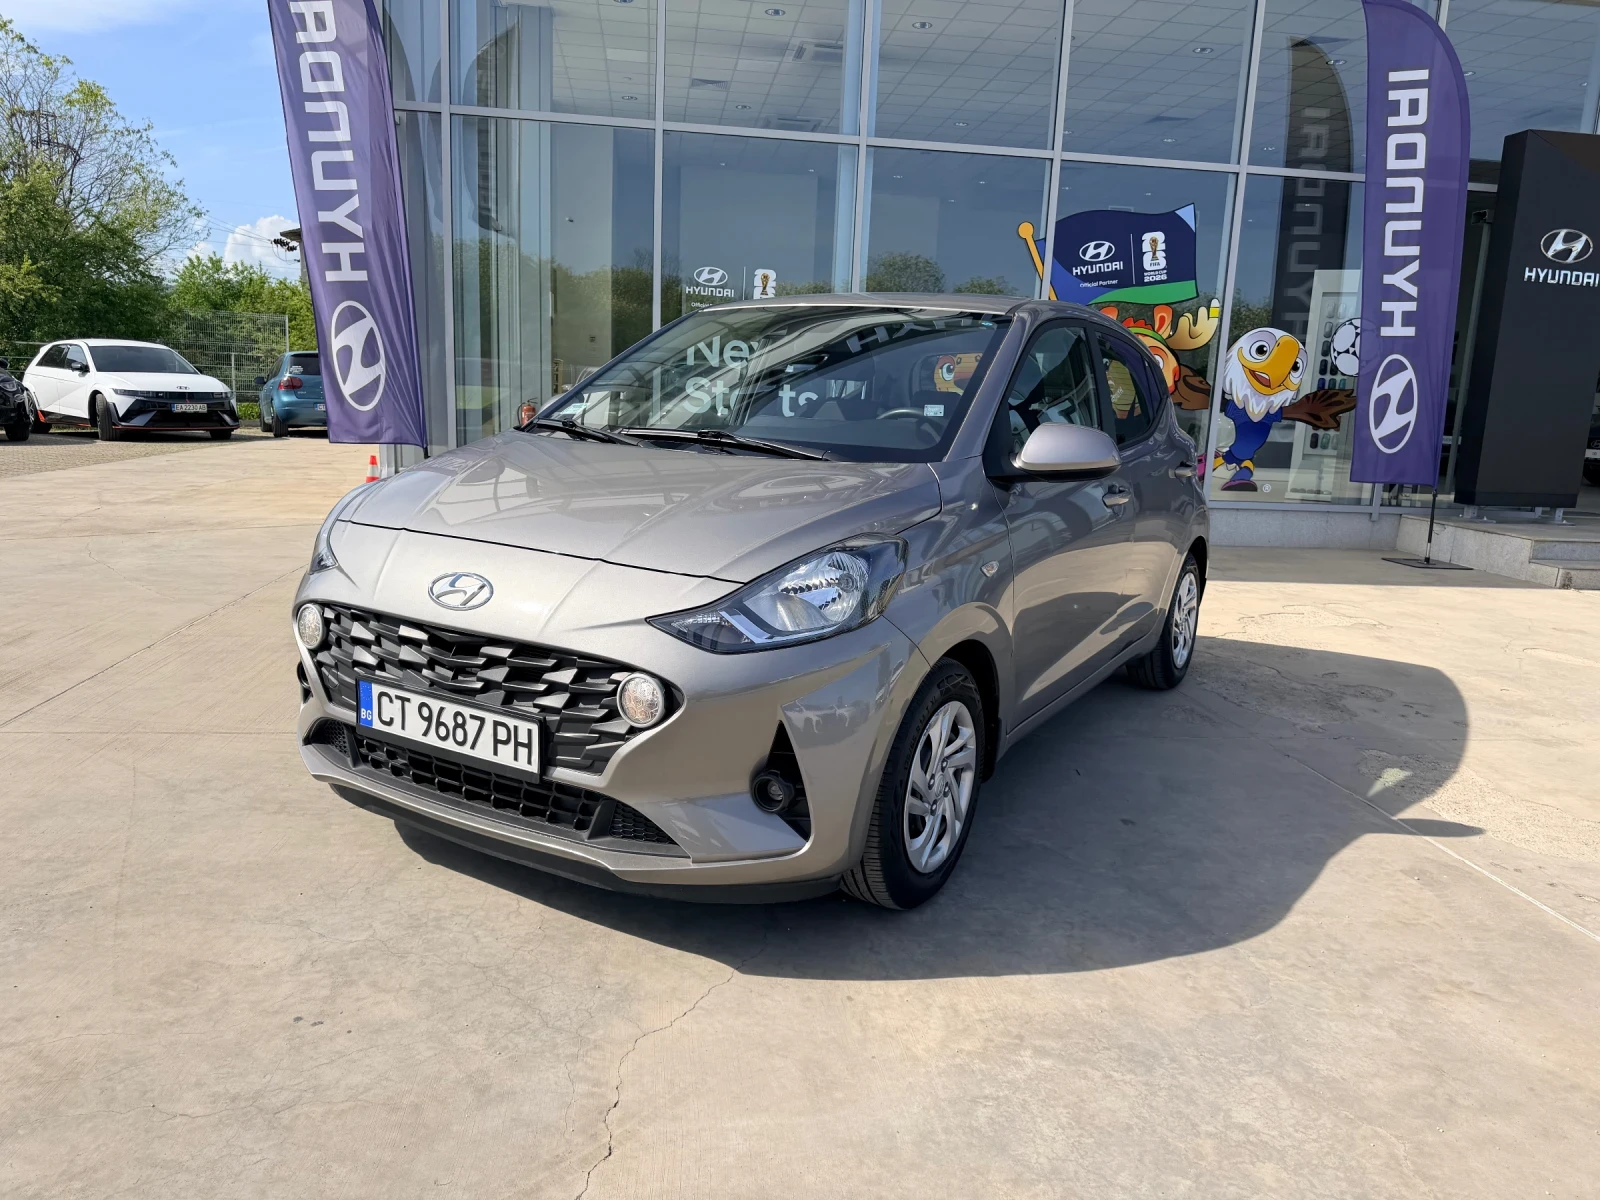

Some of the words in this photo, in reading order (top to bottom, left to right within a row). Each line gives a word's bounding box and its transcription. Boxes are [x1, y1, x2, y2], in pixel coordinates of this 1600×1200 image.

[1072, 261, 1124, 276] HYUNDAI
[1143, 274, 1168, 282] 2026
[1523, 267, 1600, 287] HYUNDAI
[685, 286, 735, 298] HYUNDAI
[361, 708, 372, 720] BG
[377, 691, 411, 731] CT
[417, 701, 486, 751] 9687
[493, 719, 533, 766] PH
